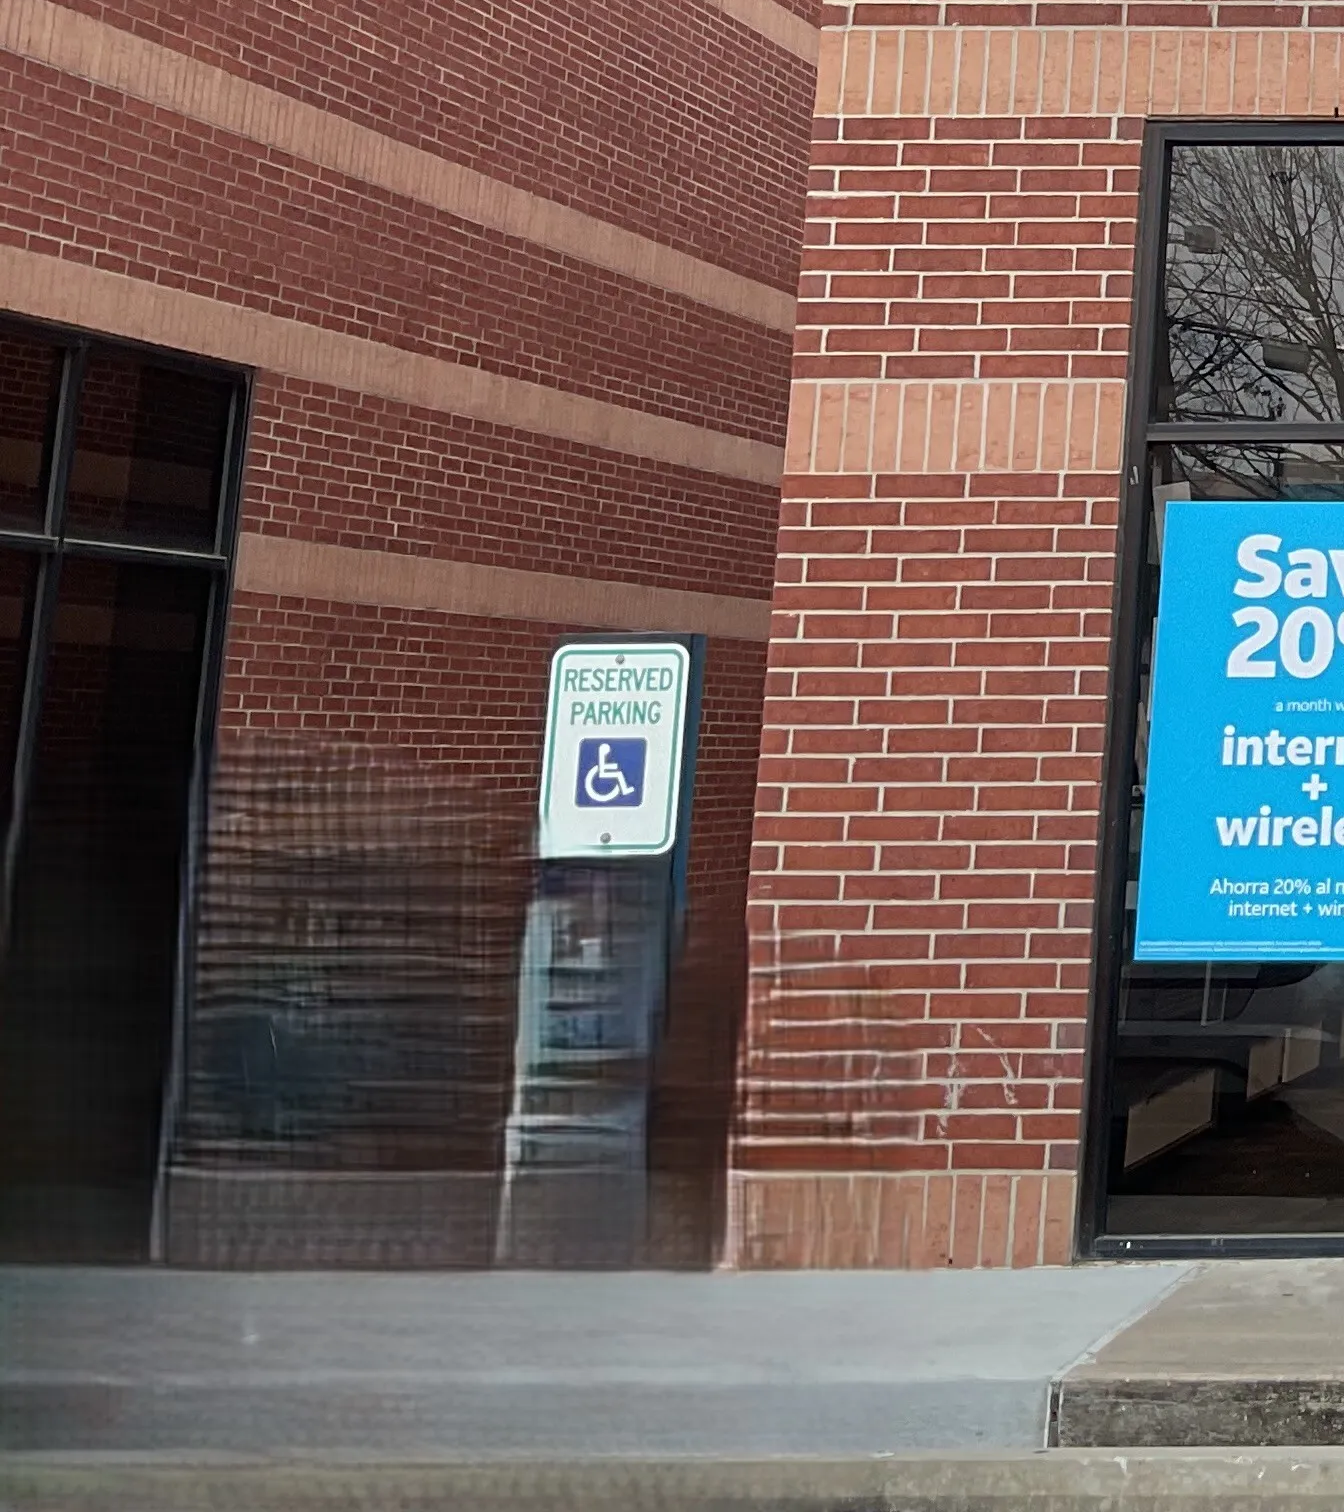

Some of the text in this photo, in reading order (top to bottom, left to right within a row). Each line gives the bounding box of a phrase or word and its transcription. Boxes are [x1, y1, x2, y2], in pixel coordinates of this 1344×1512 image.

[564, 667, 673, 692] RESERVED
[570, 701, 662, 725] PARKING
[1275, 702, 1283, 712] a
[1286, 699, 1332, 712] month
[1301, 773, 1328, 800] +
[1209, 878, 1269, 895] Ahorra
[1273, 879, 1311, 895] 20%
[1315, 878, 1331, 894] al
[1228, 900, 1298, 916] internet
[1303, 903, 1313, 915] +
